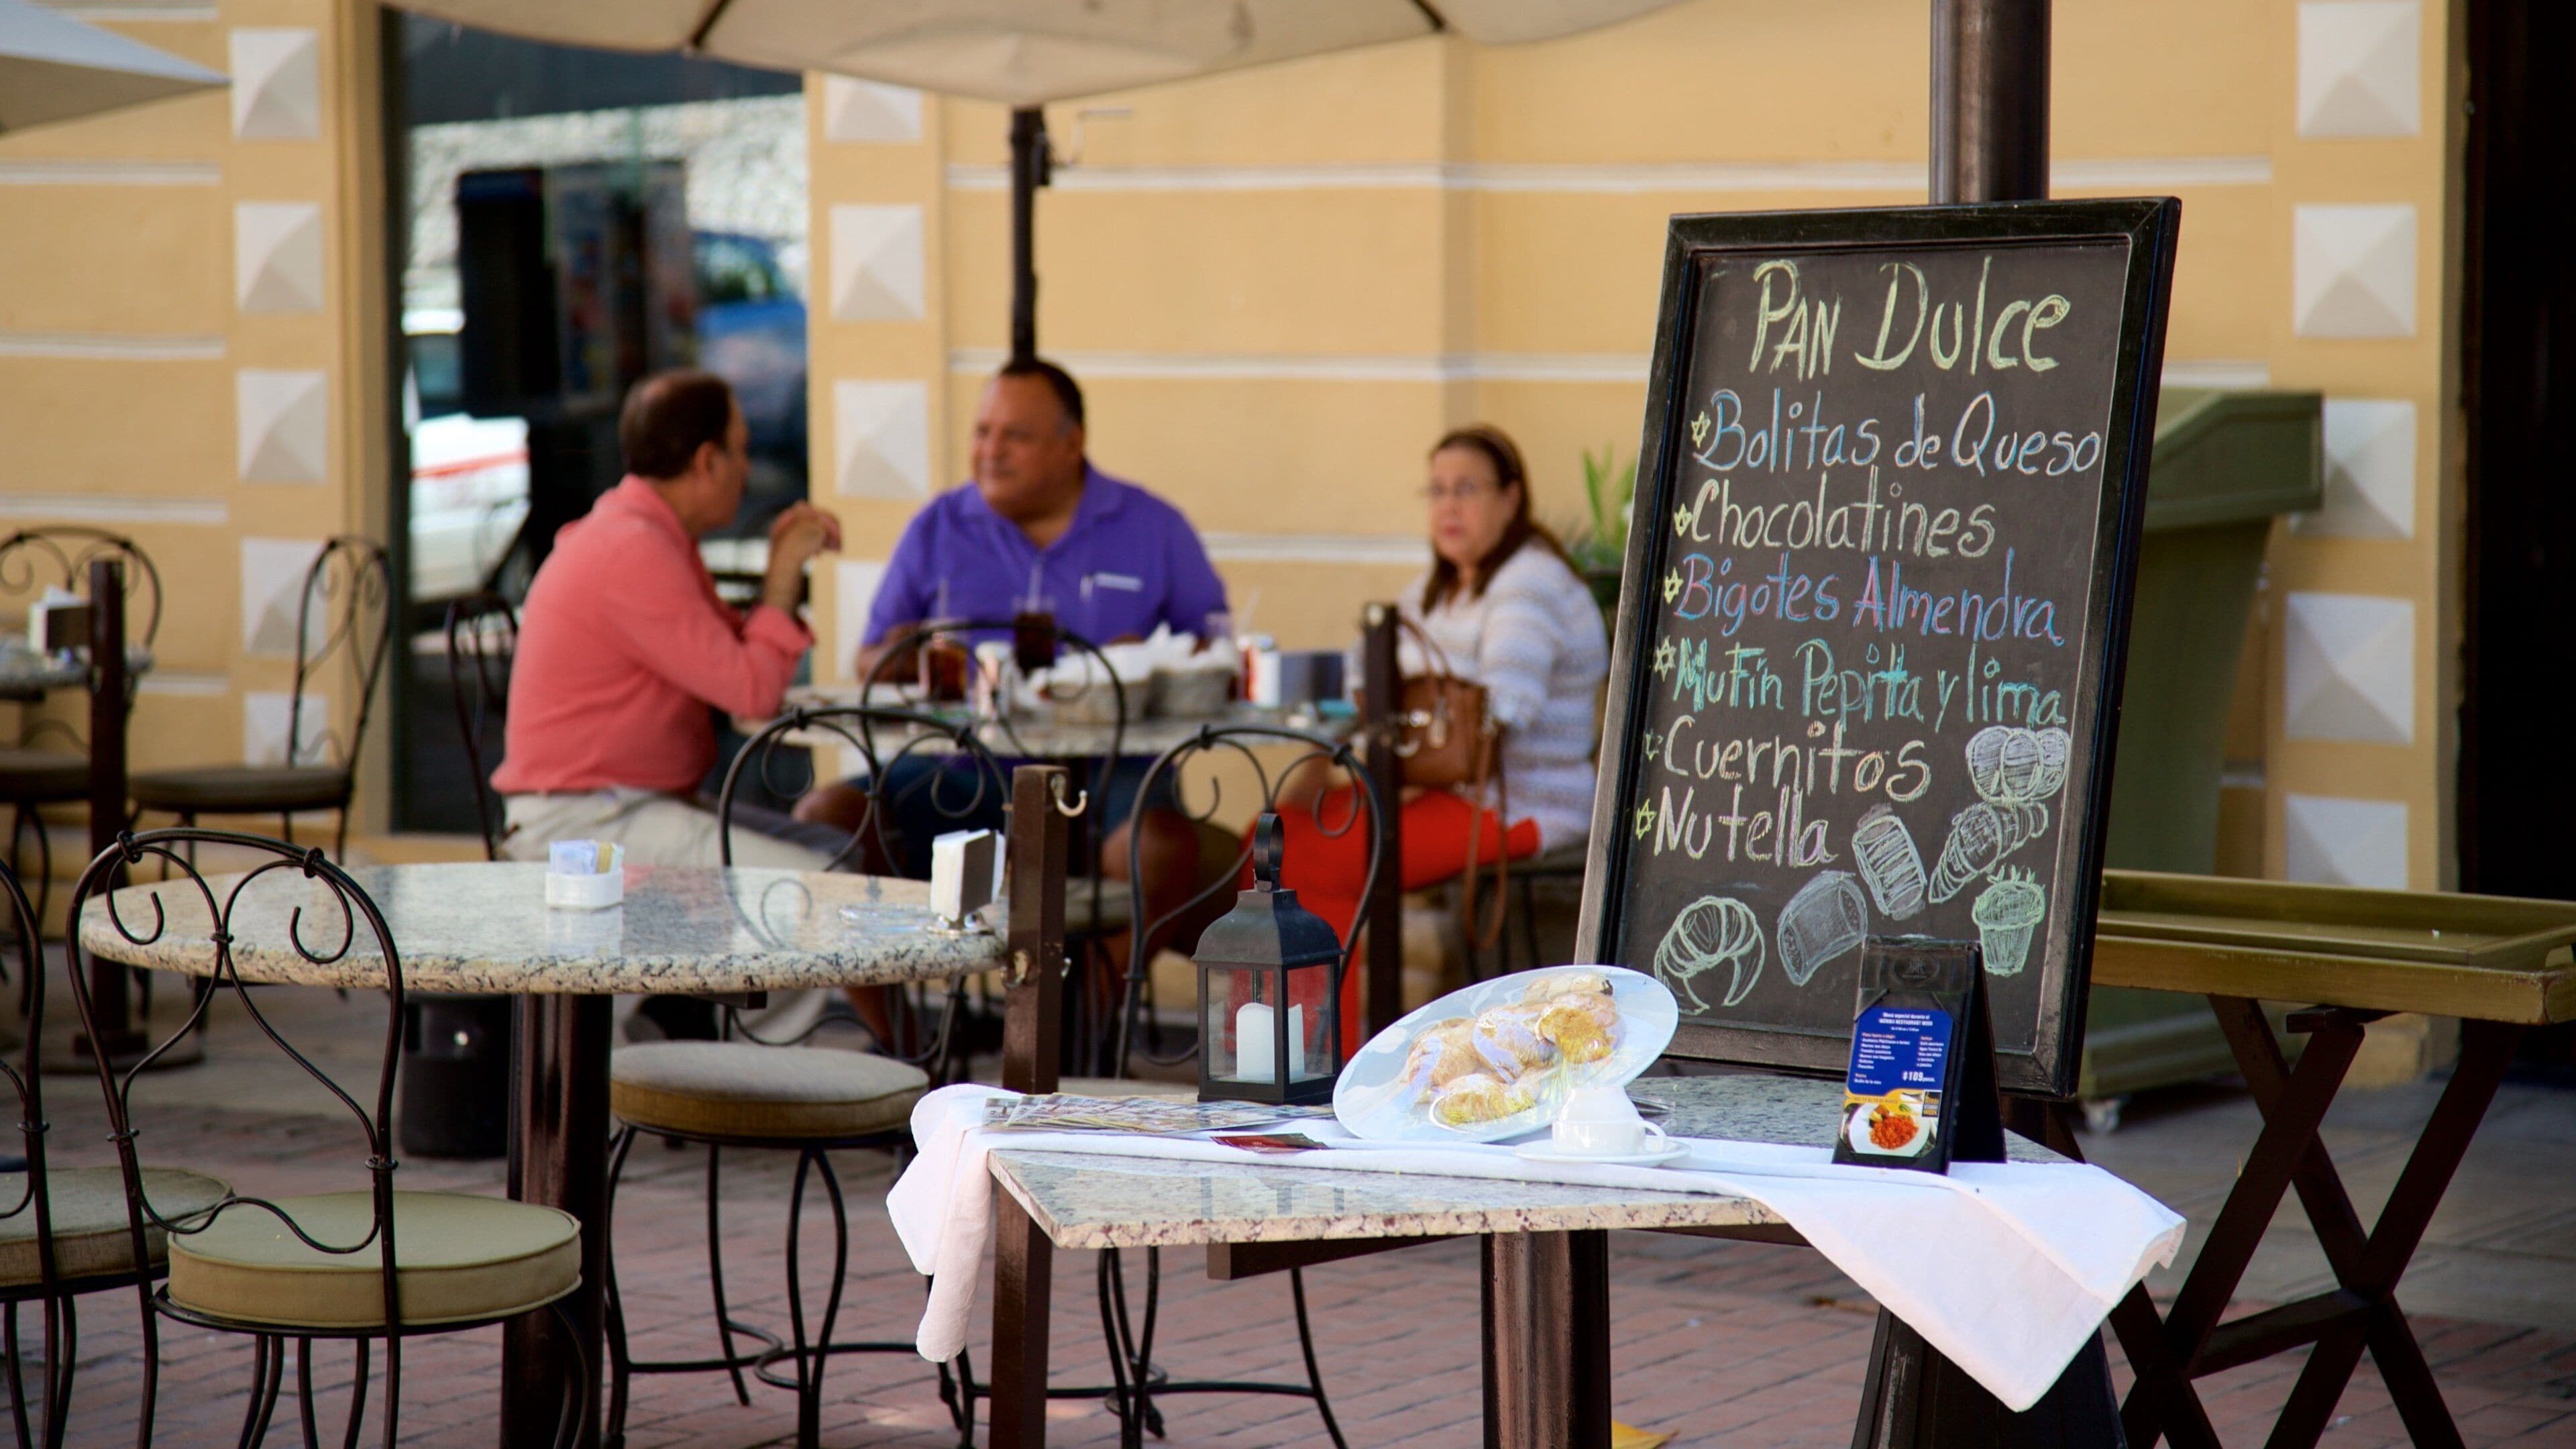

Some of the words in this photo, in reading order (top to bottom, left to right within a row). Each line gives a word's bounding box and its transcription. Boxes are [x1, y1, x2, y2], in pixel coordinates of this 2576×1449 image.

[1750, 258, 1843, 382] PAN
[1693, 387, 1880, 473] Bolitas
[1894, 392, 1939, 470] de
[1951, 390, 2102, 476] Queso
[1690, 464, 1998, 558] Chocolatines
[1673, 551, 1840, 637] Bigotes
[1853, 547, 2065, 647] Almendra
[1934, 668, 1960, 733] y
[1966, 643, 2067, 726] lima
[1664, 714, 1931, 802] Cuernitos
[1654, 784, 1840, 867] Nutella
